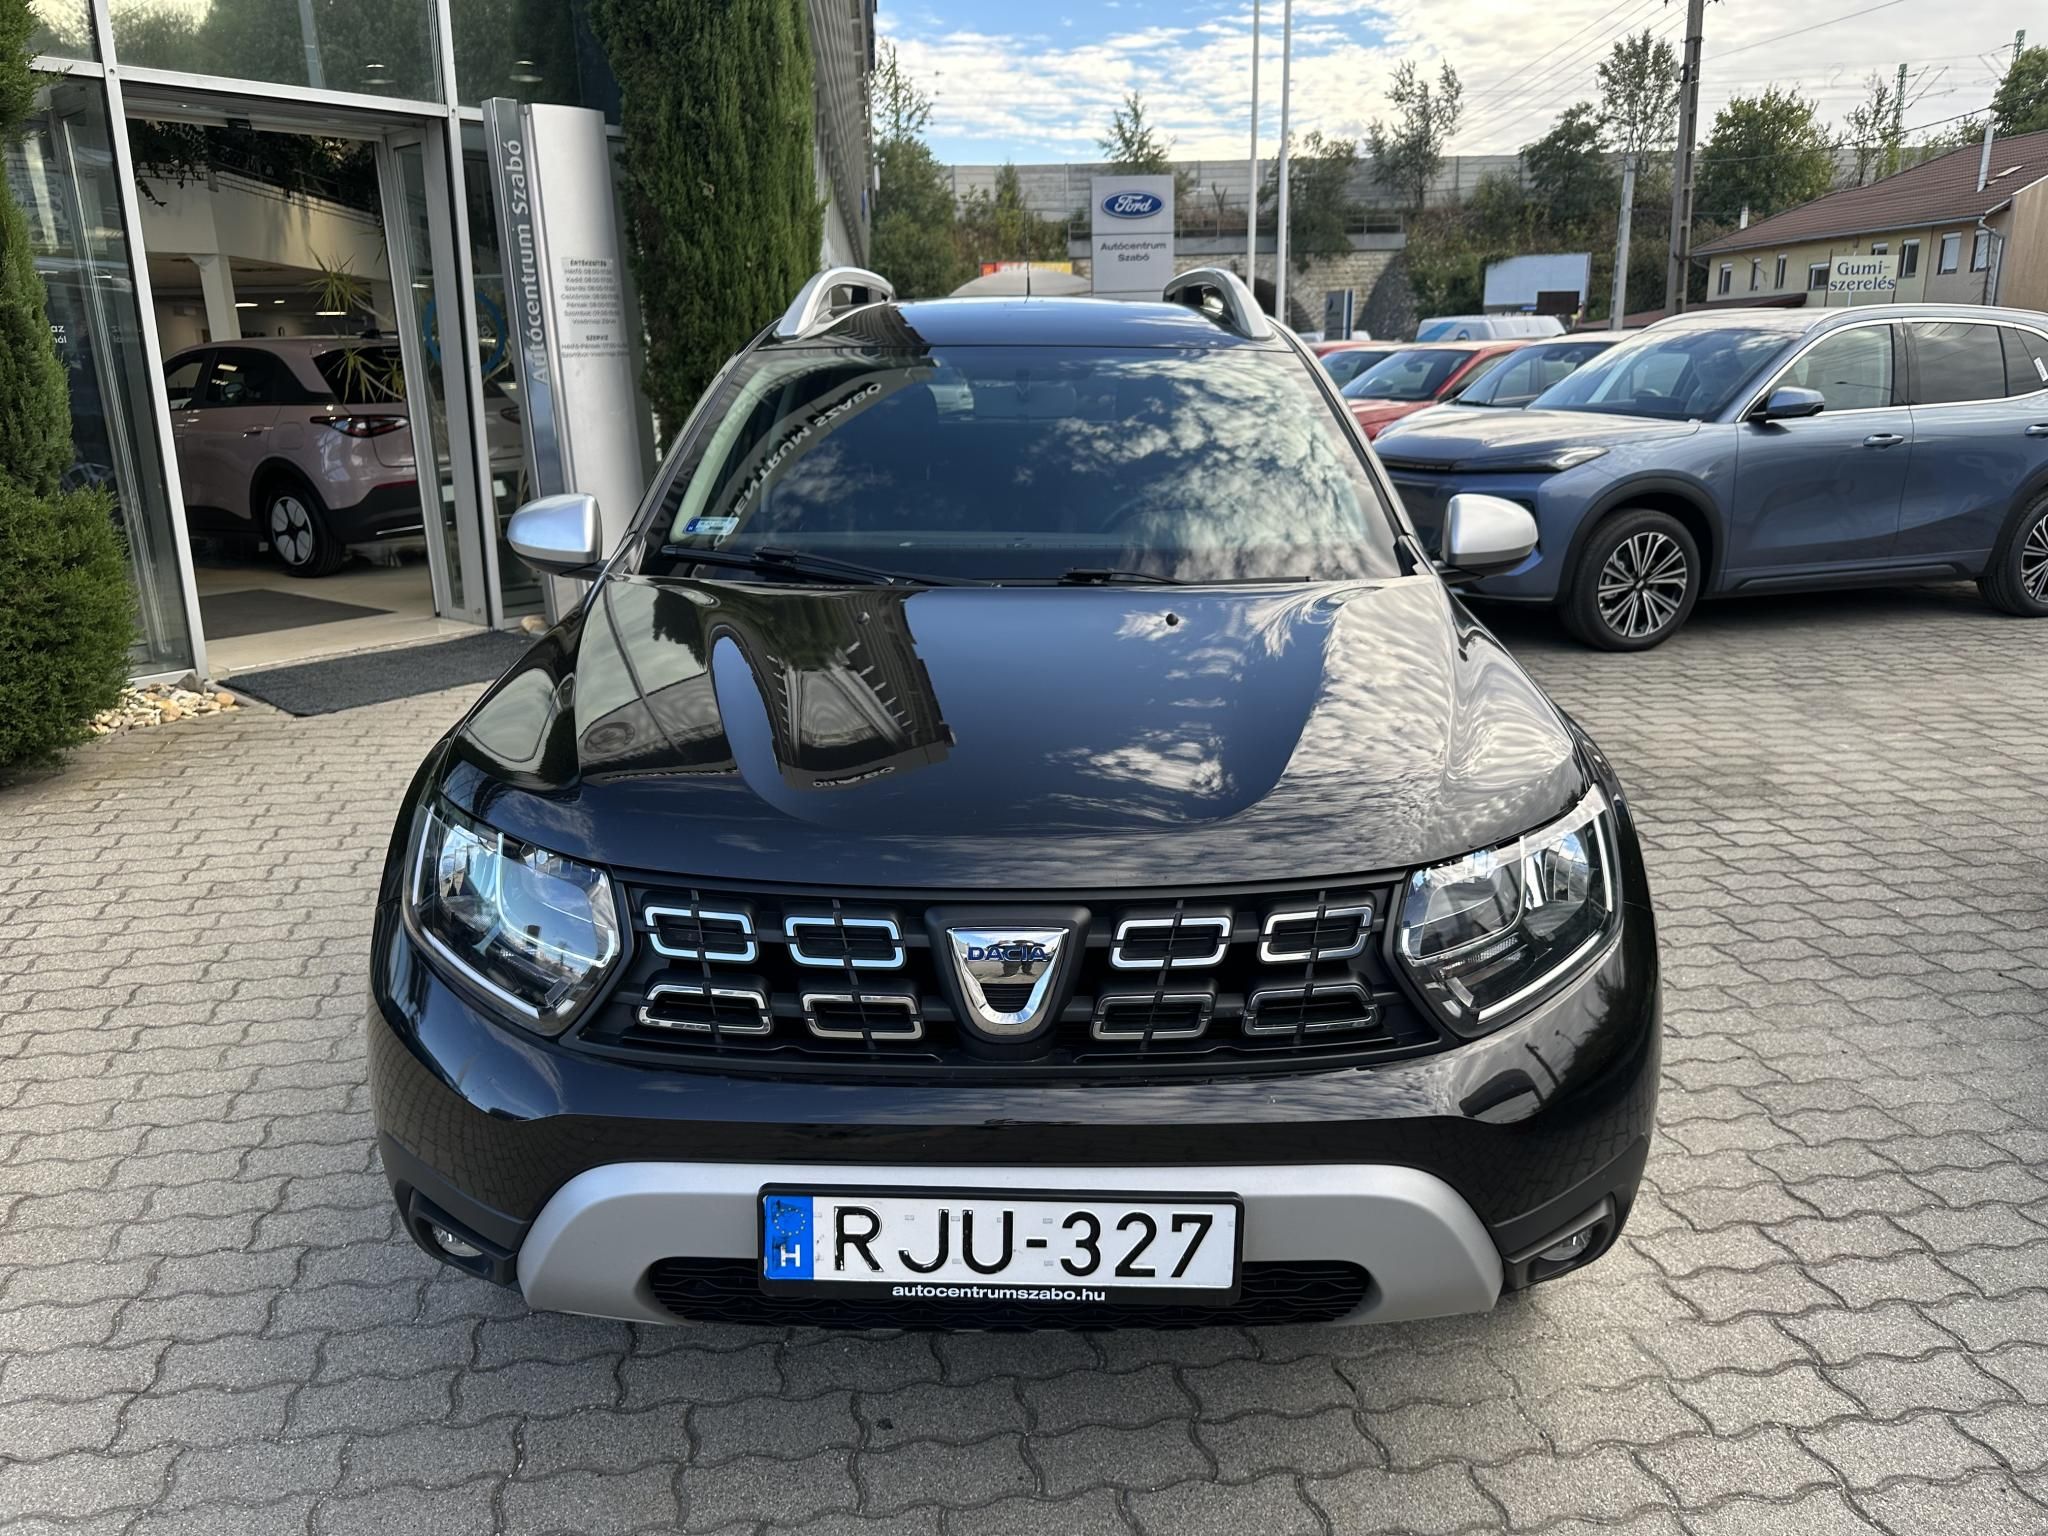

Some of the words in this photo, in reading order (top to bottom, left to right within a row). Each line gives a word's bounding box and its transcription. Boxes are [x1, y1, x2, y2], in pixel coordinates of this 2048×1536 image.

[502, 139, 528, 215] Szabó
[1114, 195, 1153, 212] Ford
[1101, 242, 1167, 251] Autócentrum
[1118, 253, 1150, 262] Szabó
[1837, 260, 1891, 275] Gumi-
[1829, 275, 1896, 292] szerelés
[517, 224, 548, 385] Autócentrum
[967, 946, 1048, 962] DACIA
[779, 1244, 802, 1268] H
[833, 1205, 1214, 1278] RJU-327
[892, 1284, 1106, 1302] autocentrumszabo.hu
